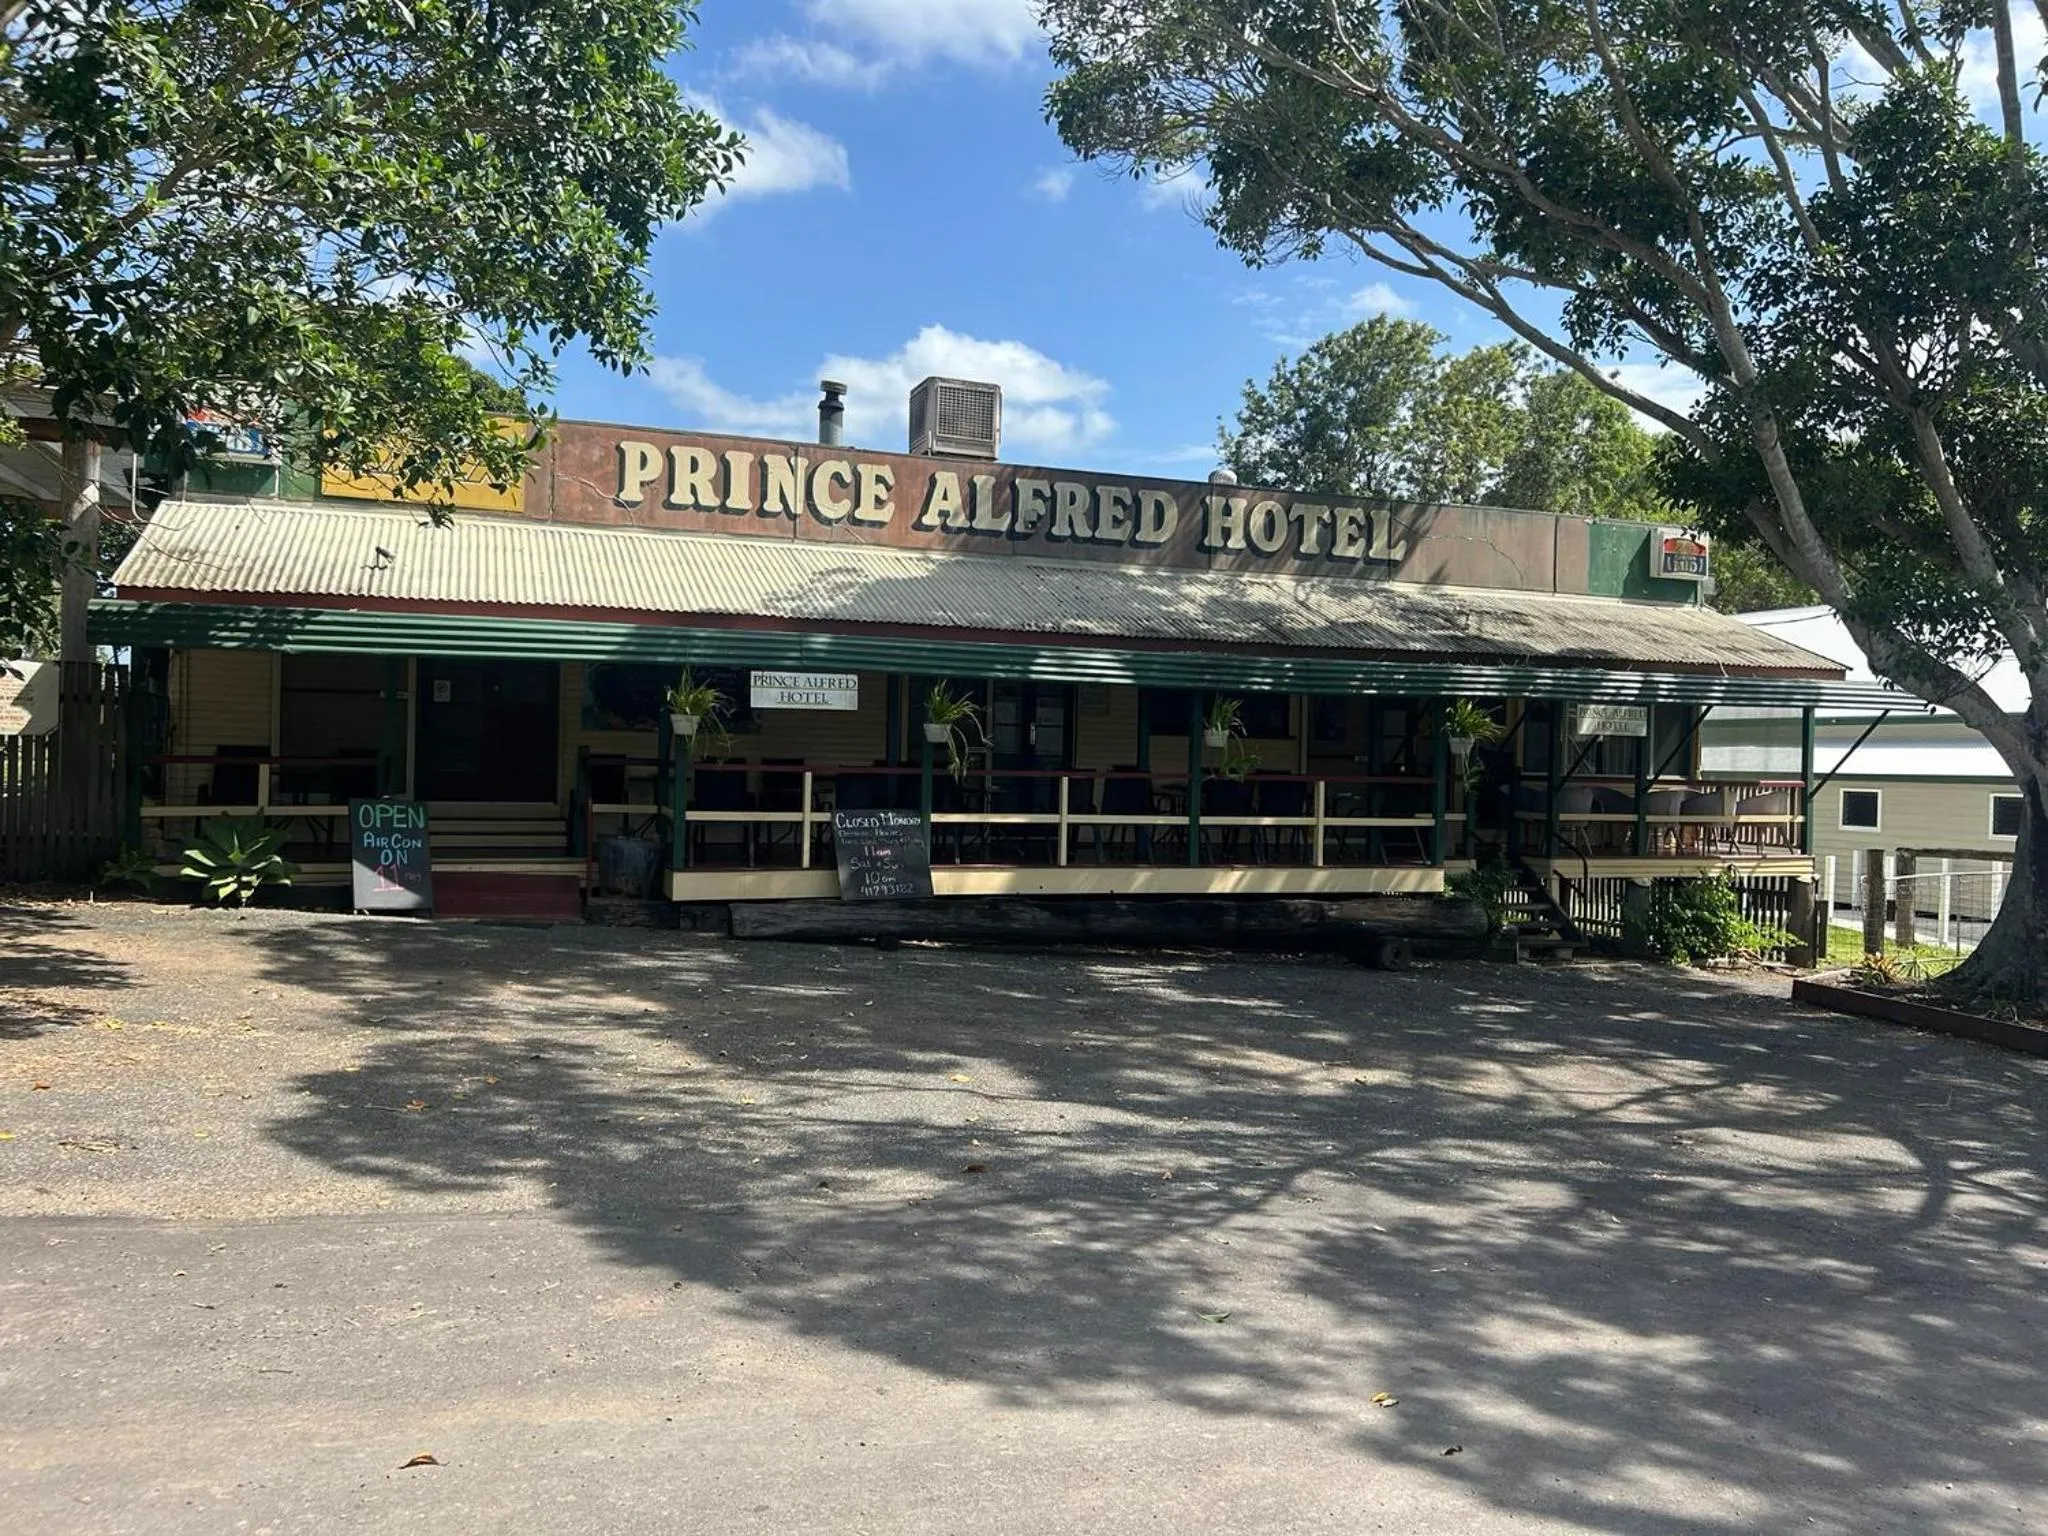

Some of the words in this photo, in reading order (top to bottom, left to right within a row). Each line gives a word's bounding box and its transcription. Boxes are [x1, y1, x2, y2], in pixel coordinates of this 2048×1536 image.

[617, 441, 895, 525] PRINCE
[915, 472, 1179, 547] ALFRED
[1200, 497, 1407, 562] HOTEL
[753, 674, 800, 688] PRINCE
[803, 676, 857, 689] ALFRED
[780, 691, 829, 703] HOTEL
[359, 804, 425, 829] OPEN
[380, 848, 408, 865] ON
